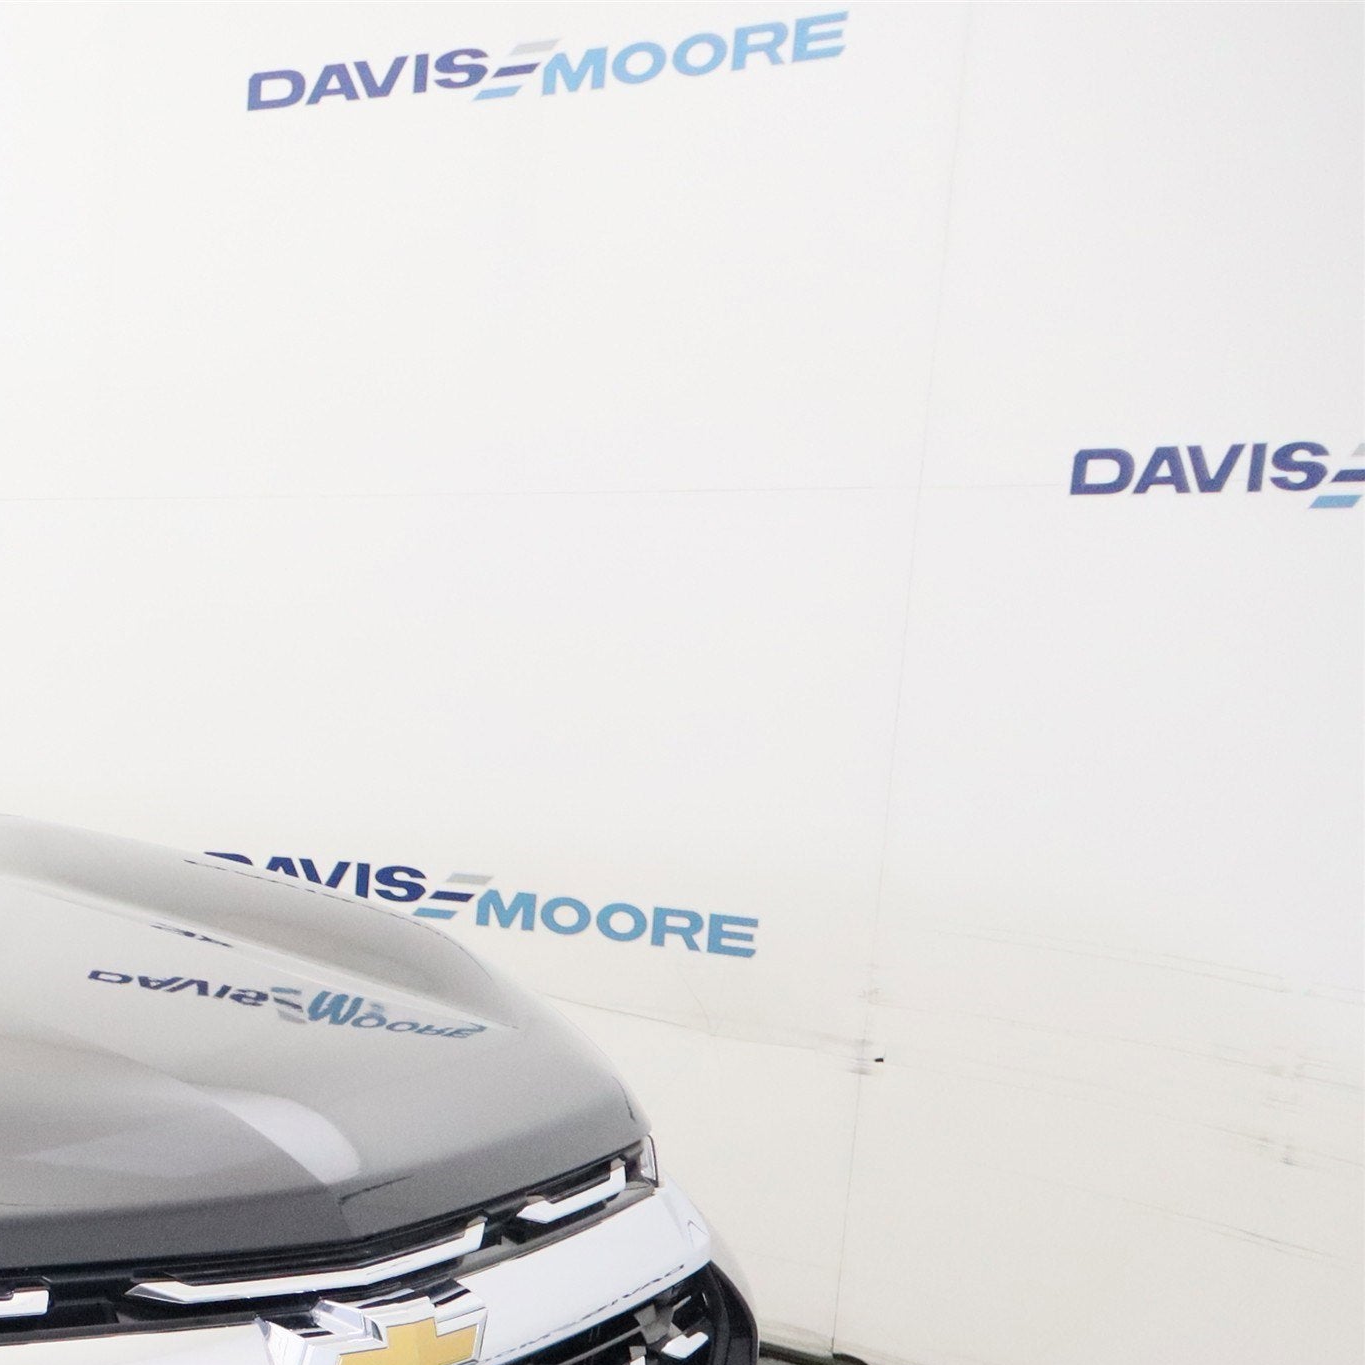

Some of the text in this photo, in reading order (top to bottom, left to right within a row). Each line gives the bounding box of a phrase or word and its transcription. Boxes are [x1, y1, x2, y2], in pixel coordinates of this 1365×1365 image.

[246, 10, 849, 112] DAVIS MOORE
[1069, 440, 1331, 496] DAVIS
[475, 888, 760, 959] MOORE
